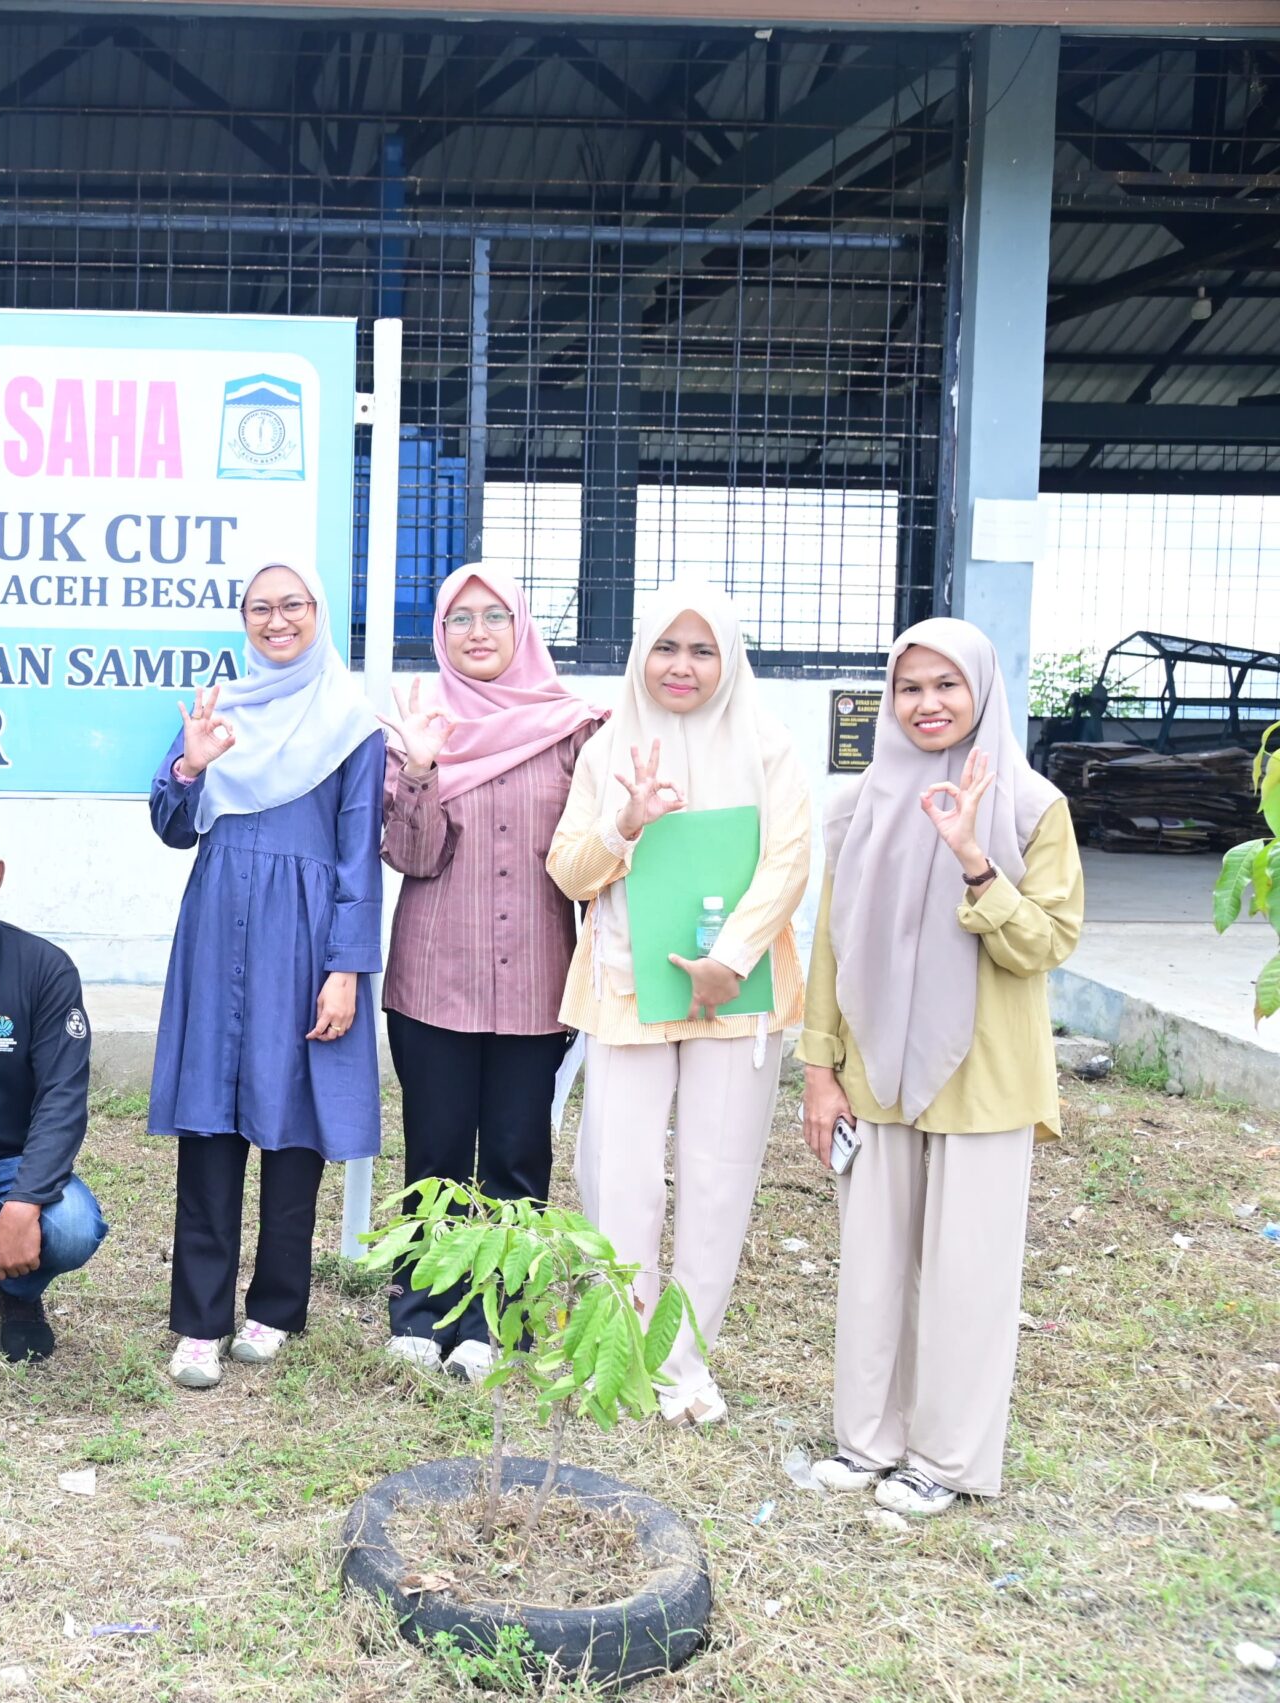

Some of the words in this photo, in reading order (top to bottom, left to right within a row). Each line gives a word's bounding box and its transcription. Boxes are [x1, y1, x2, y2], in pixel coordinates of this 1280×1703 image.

[105, 514, 238, 565] CUT
[0, 575, 109, 607] ACEH
[68, 648, 239, 689] SAMPA
